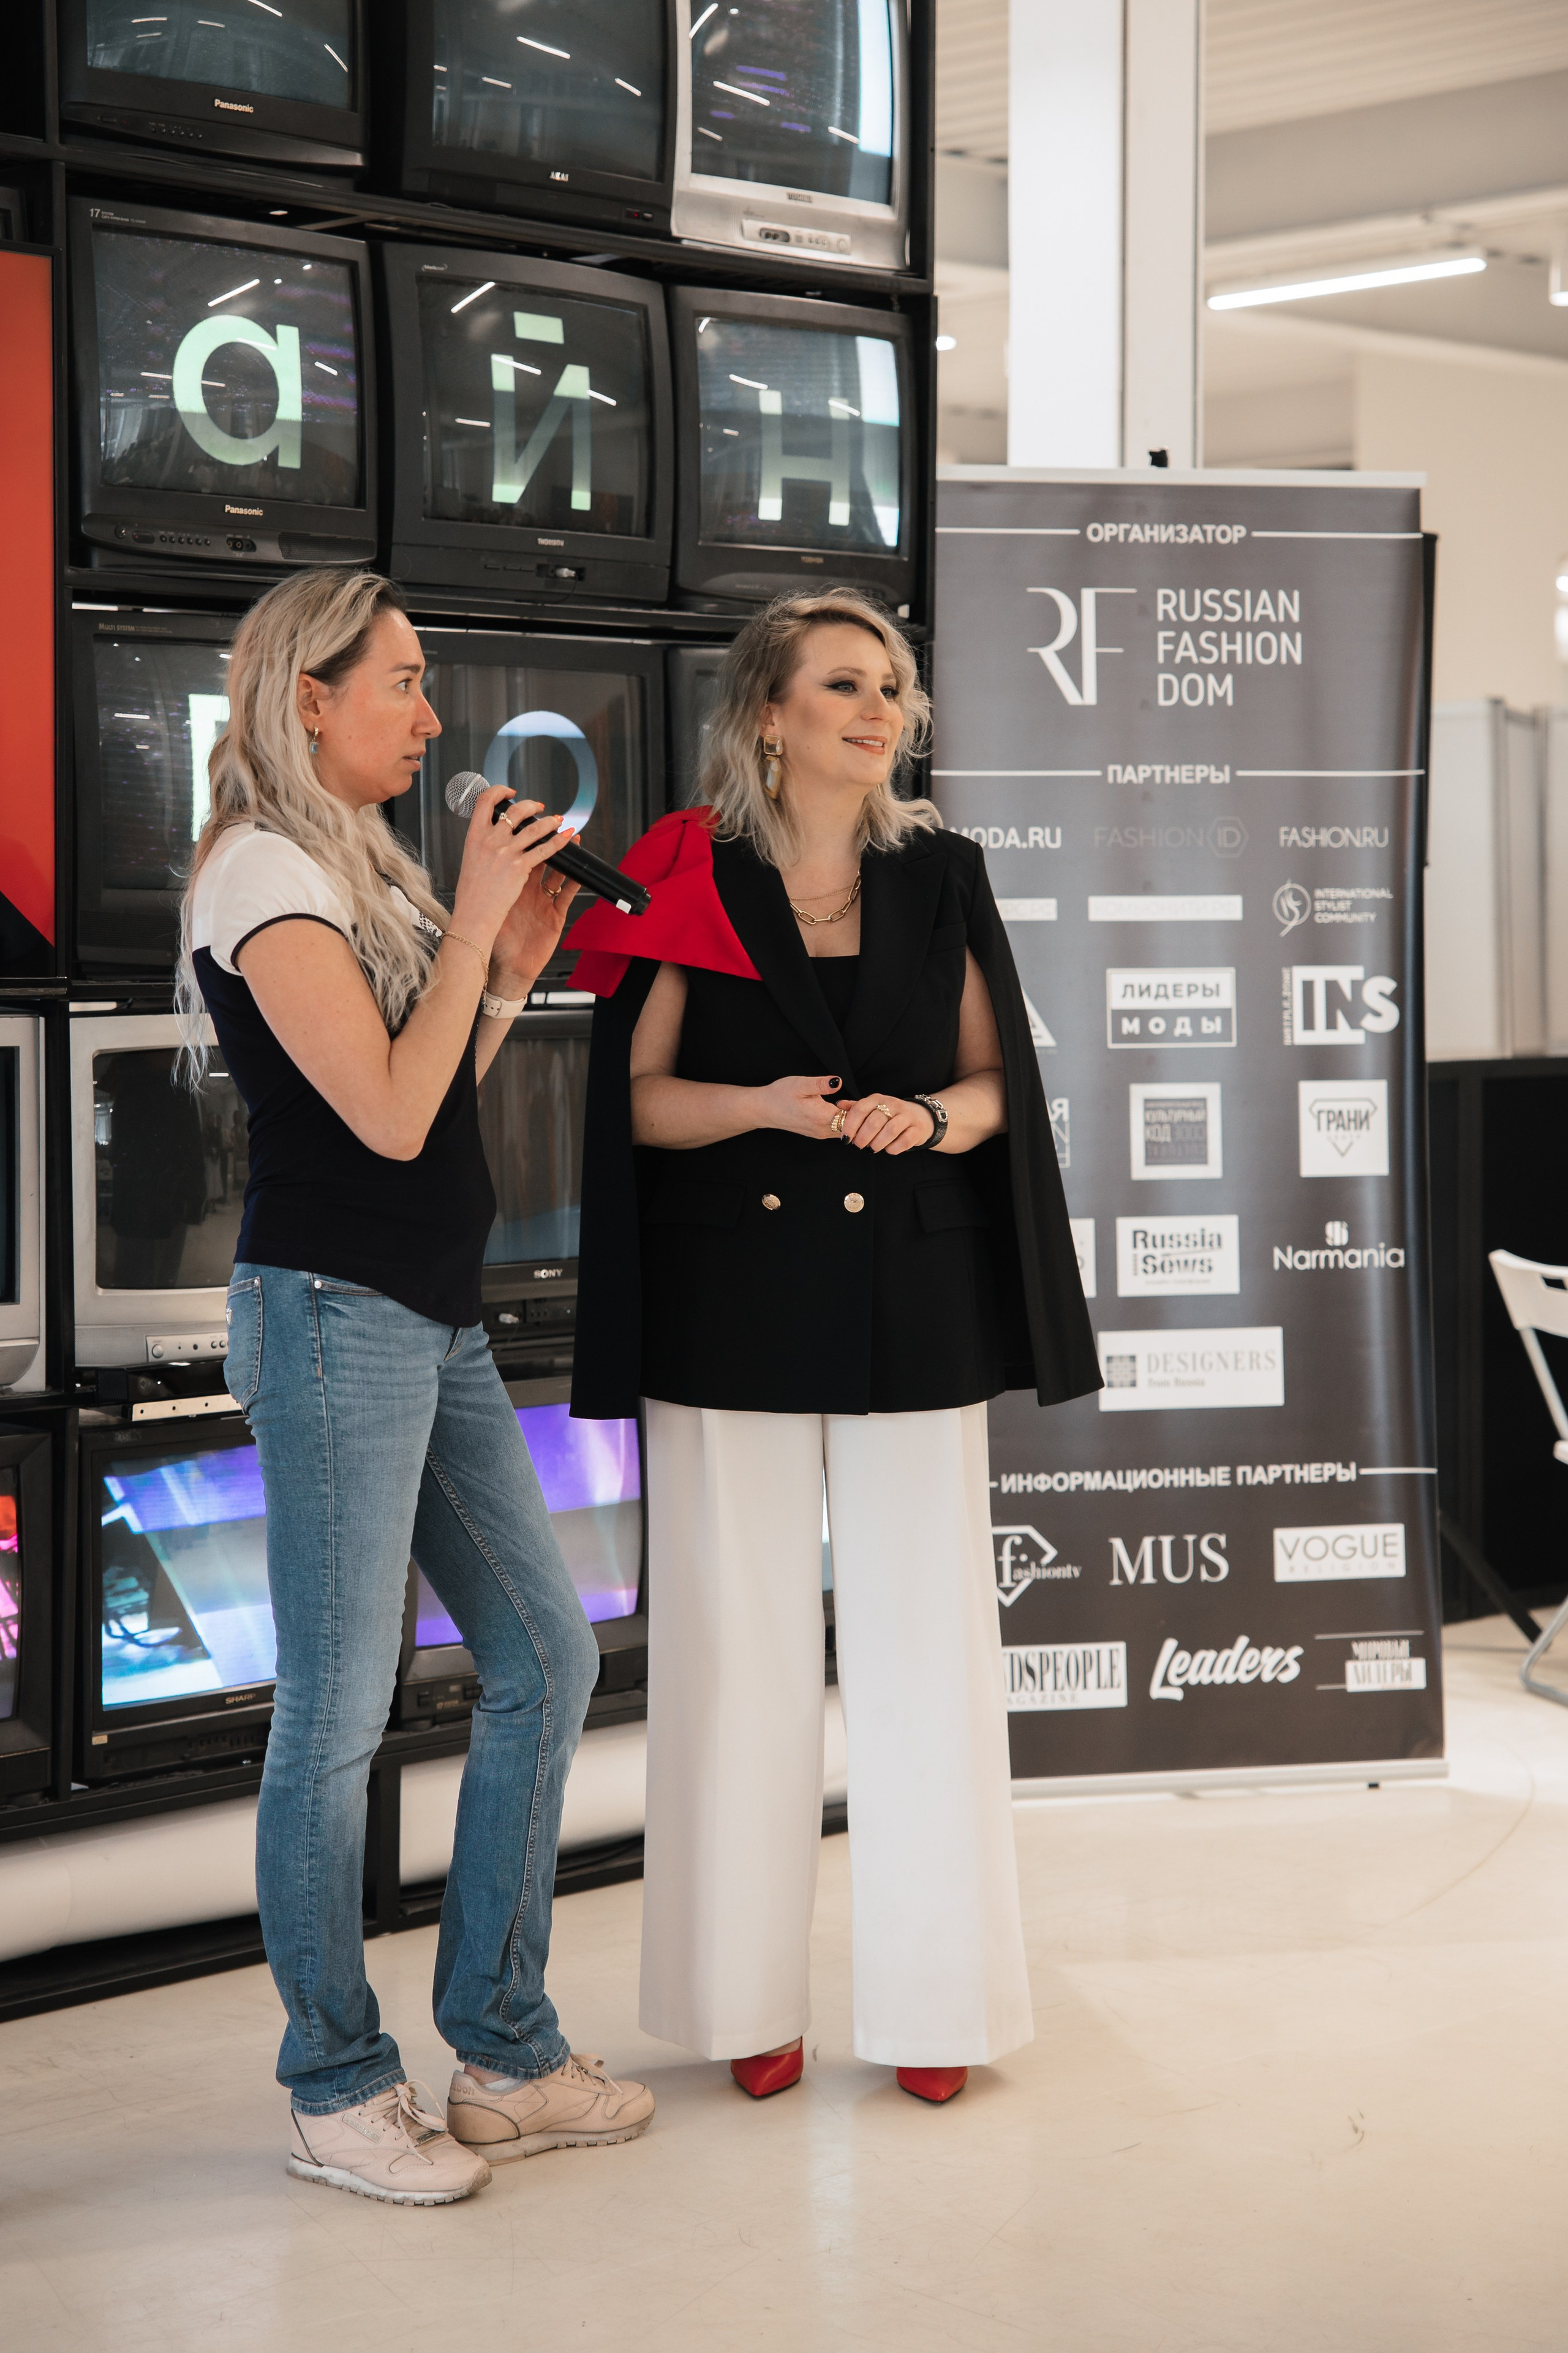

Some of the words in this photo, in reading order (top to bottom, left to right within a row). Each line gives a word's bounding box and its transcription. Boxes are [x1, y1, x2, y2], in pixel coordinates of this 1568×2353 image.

[214, 99, 254, 113] Panasonic
[549, 171, 569, 182] AKAI
[90, 208, 101, 217] 17
[225, 504, 263, 516] Panasonic
[1086, 523, 1247, 545] ОРГАНИЗАТОР
[1156, 588, 1300, 623] RUSSIAN
[1156, 630, 1303, 665] FASHION
[1157, 672, 1234, 708] DOM
[1107, 764, 1231, 785] ПАРТНЕРЫ
[1094, 827, 1204, 848] FASHION
[1314, 888, 1393, 899] INTERNATIONAL
[1314, 899, 1352, 912] STYLIST
[1314, 911, 1377, 924] COMMUNITY
[1121, 982, 1221, 1001] ЛИДЕРЫ
[1121, 1015, 1223, 1037] МОДЫ
[1316, 1109, 1370, 1132] ГРАНИ
[1132, 1228, 1223, 1251] Russia
[1142, 1253, 1214, 1275] Sews
[1273, 1242, 1406, 1271] Narmania
[533, 1269, 564, 1278] SONY
[1147, 1350, 1277, 1374] DESIGNERS
[1148, 1378, 1170, 1389] from
[1174, 1377, 1206, 1388] Russia
[1000, 1466, 1231, 1494] ИНФОРМАЦИОННЫЕ
[1235, 1461, 1357, 1487] ПАРТНЕРЫ
[1278, 1532, 1400, 1562] VOGUE
[1108, 1532, 1230, 1587] MUS
[1288, 1562, 1396, 1574] RELIGION
[1148, 1634, 1305, 1702] Leaders
[225, 1693, 257, 1704] SHARP
